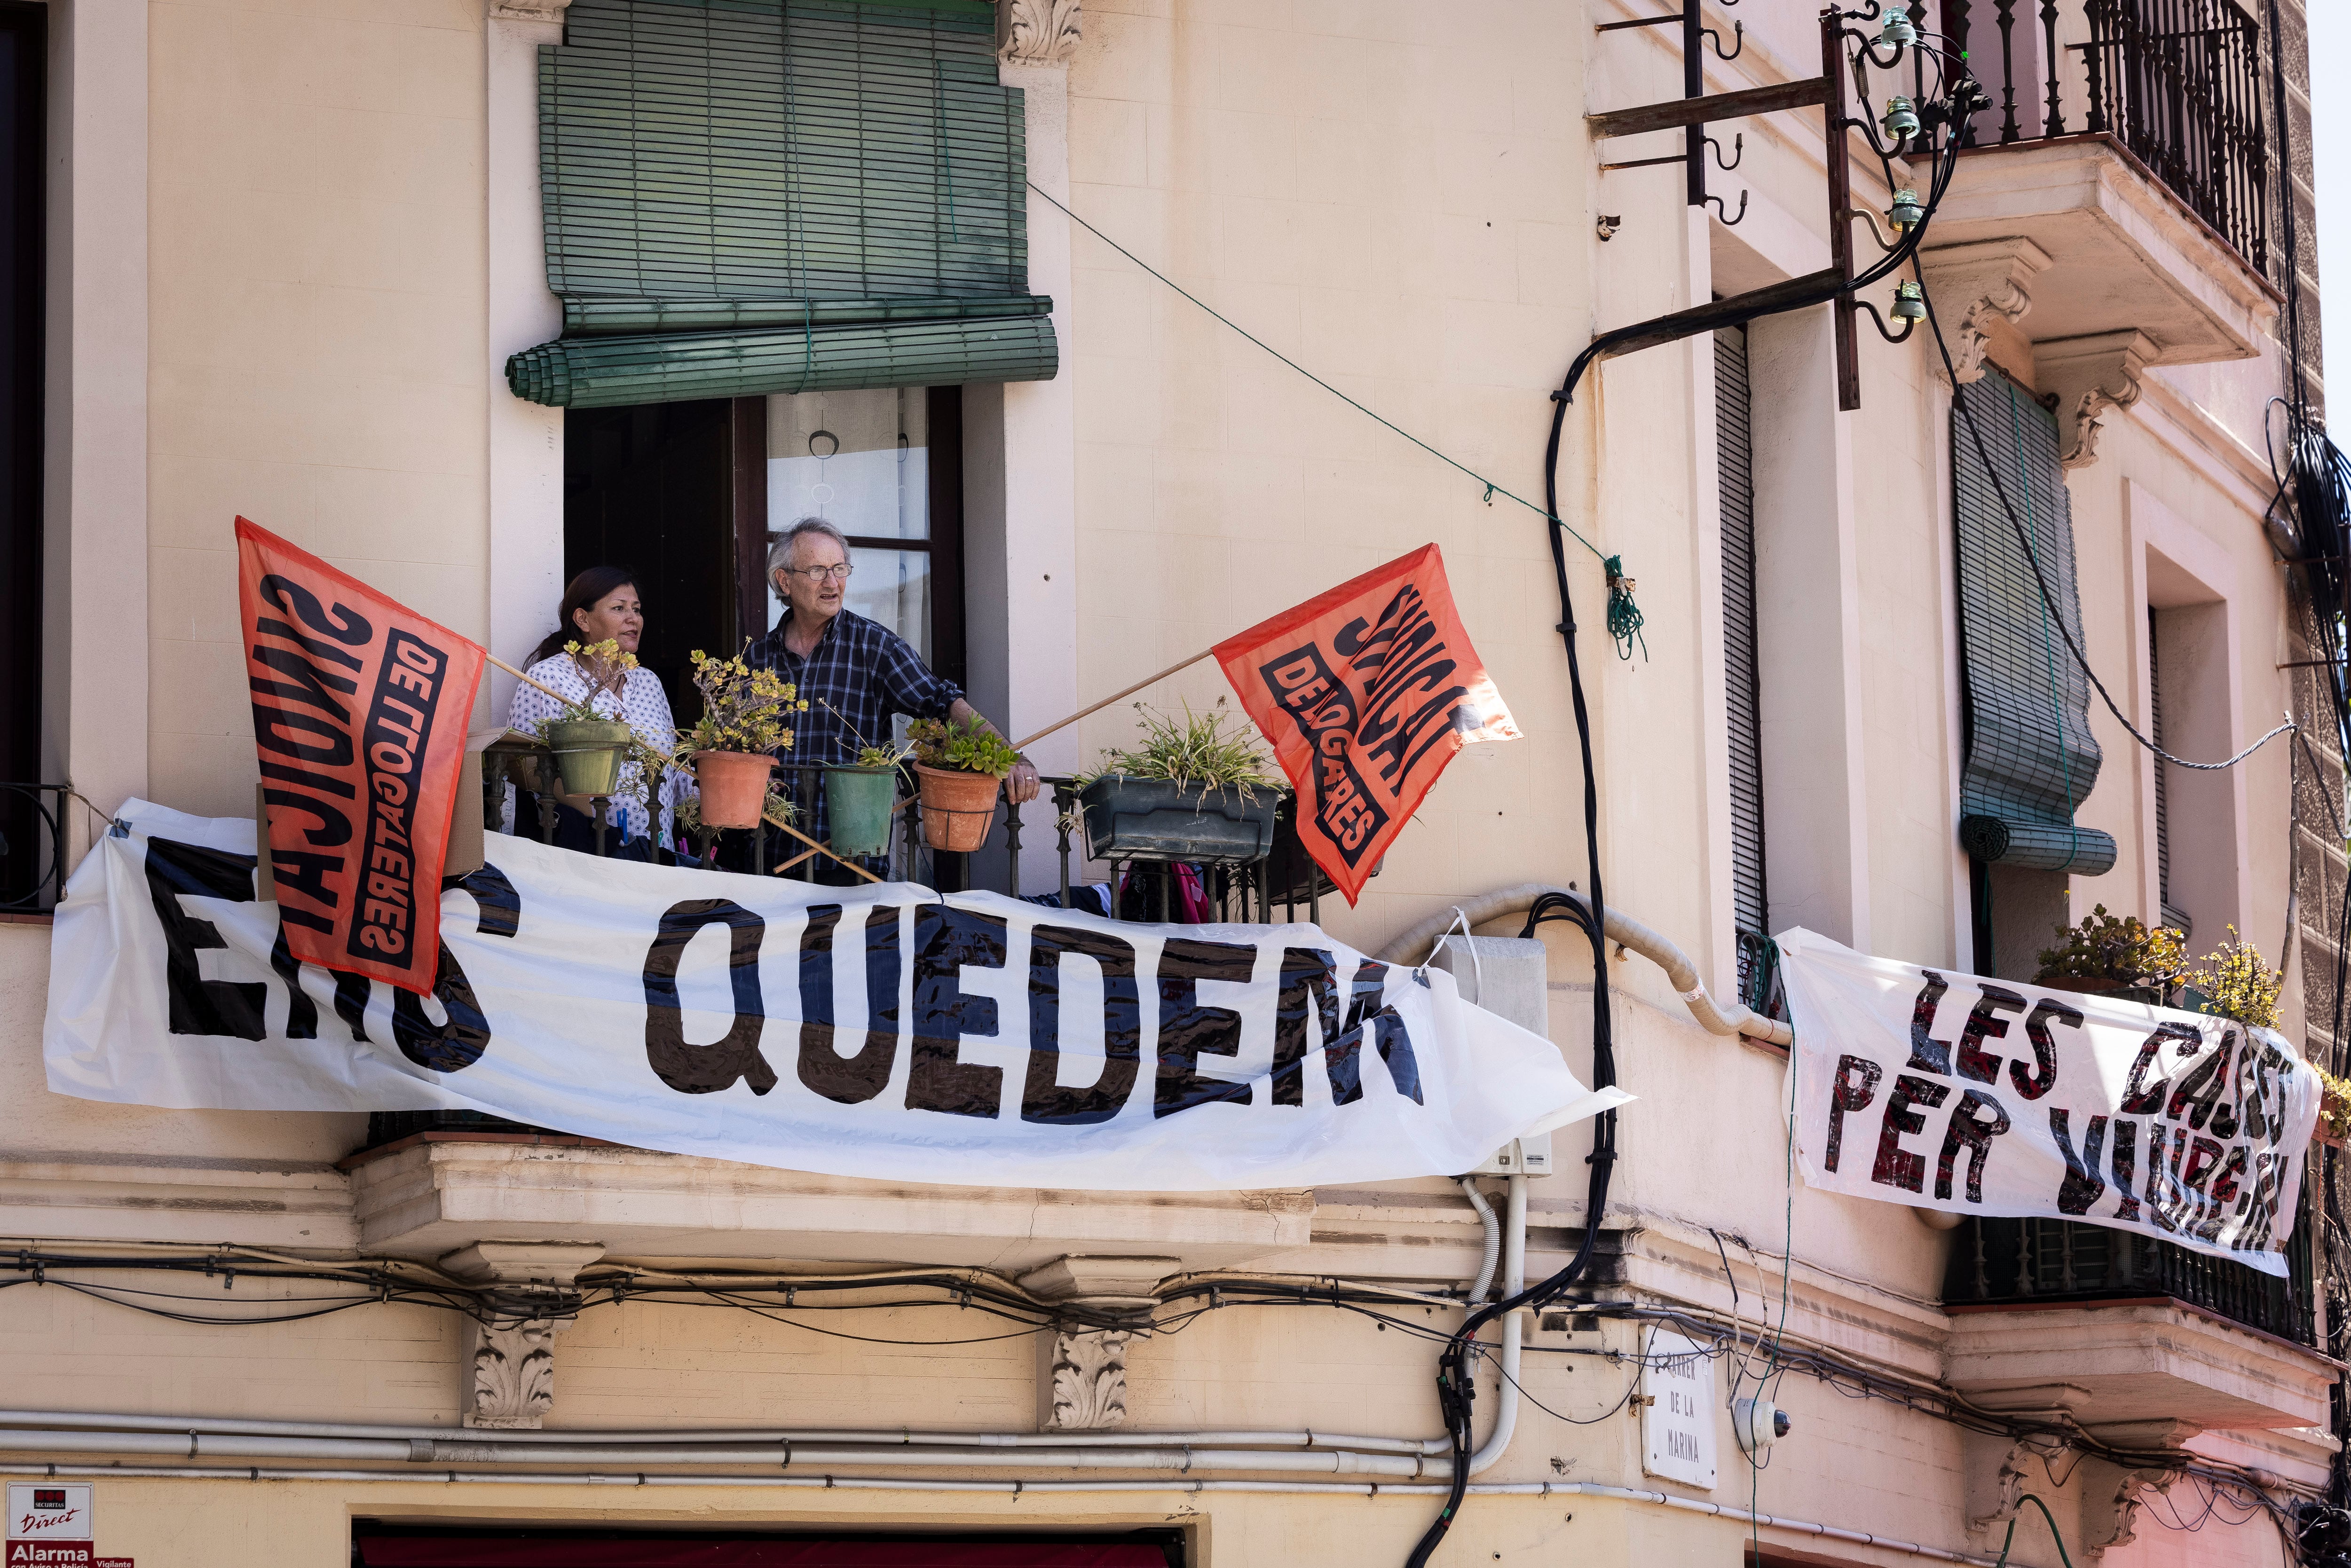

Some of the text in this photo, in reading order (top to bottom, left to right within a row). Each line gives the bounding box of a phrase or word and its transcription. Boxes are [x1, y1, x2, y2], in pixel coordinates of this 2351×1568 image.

[1273, 655, 1330, 707] DE
[643, 898, 1424, 1125] QUEDEM
[1906, 969, 2084, 1101] LES
[1824, 1055, 2011, 1204] PER
[1668, 1354, 1695, 1380] ARRER
[1671, 1391, 1694, 1418] DE LA
[1668, 1428, 1699, 1463] MARINA
[20, 1508, 81, 1533] Direct
[11, 1544, 88, 1561] Alarma
